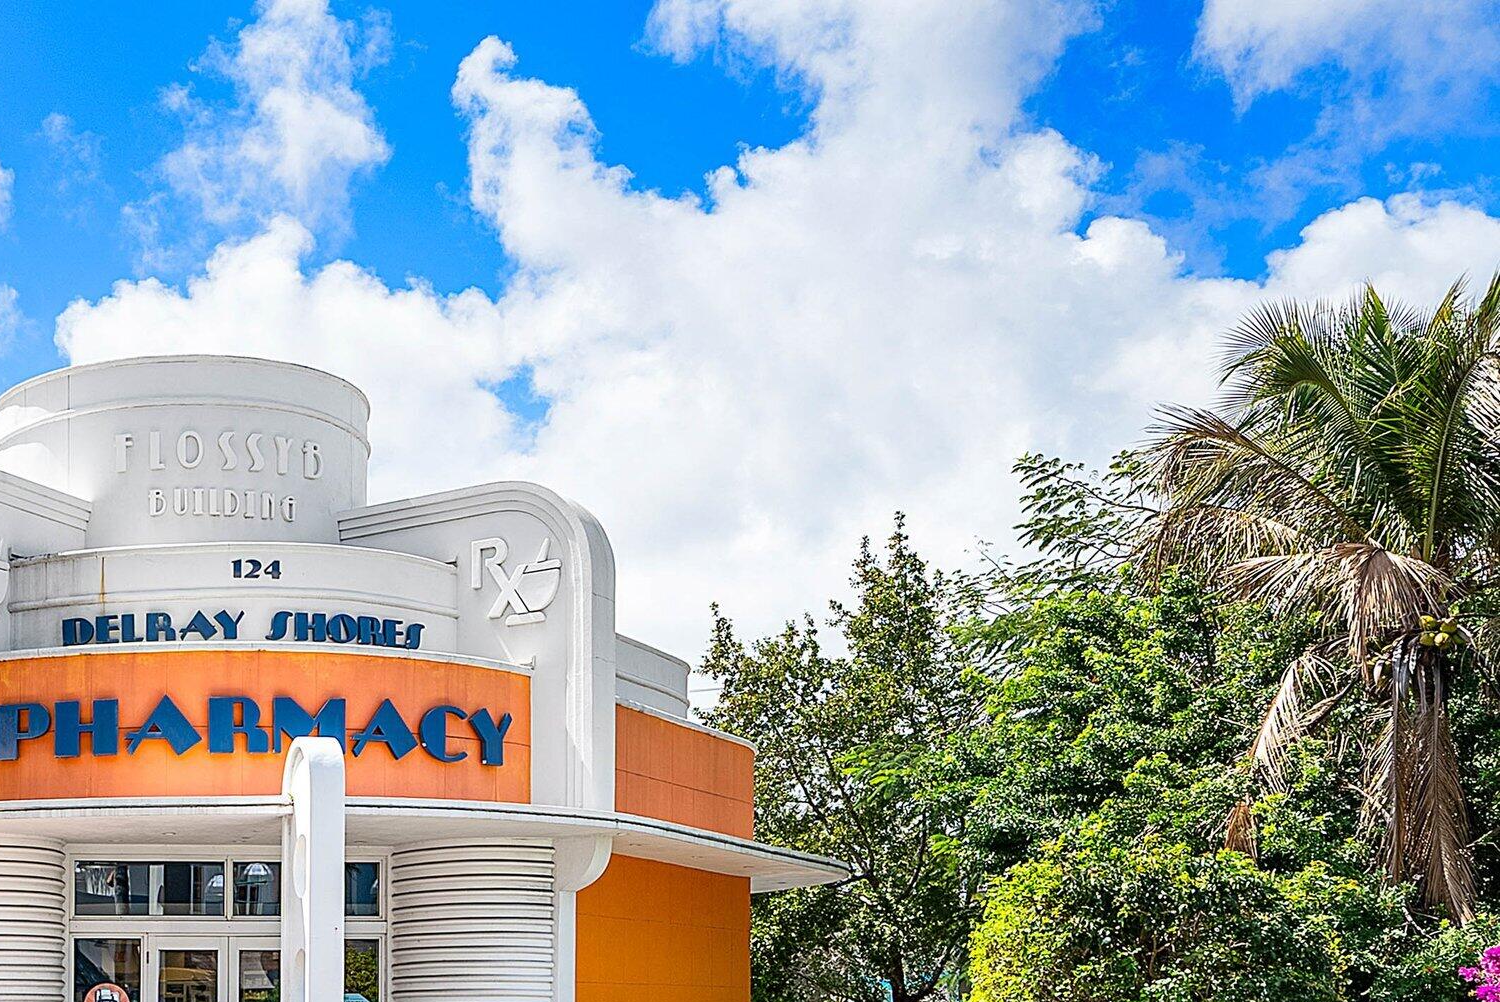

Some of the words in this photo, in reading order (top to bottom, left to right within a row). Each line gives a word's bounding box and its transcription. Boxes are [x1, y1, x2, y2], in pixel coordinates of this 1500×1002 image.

[148, 487, 297, 522] BUILDING
[231, 559, 282, 580] 124
[62, 610, 245, 646] DELRAY
[265, 610, 426, 650] SHORES
